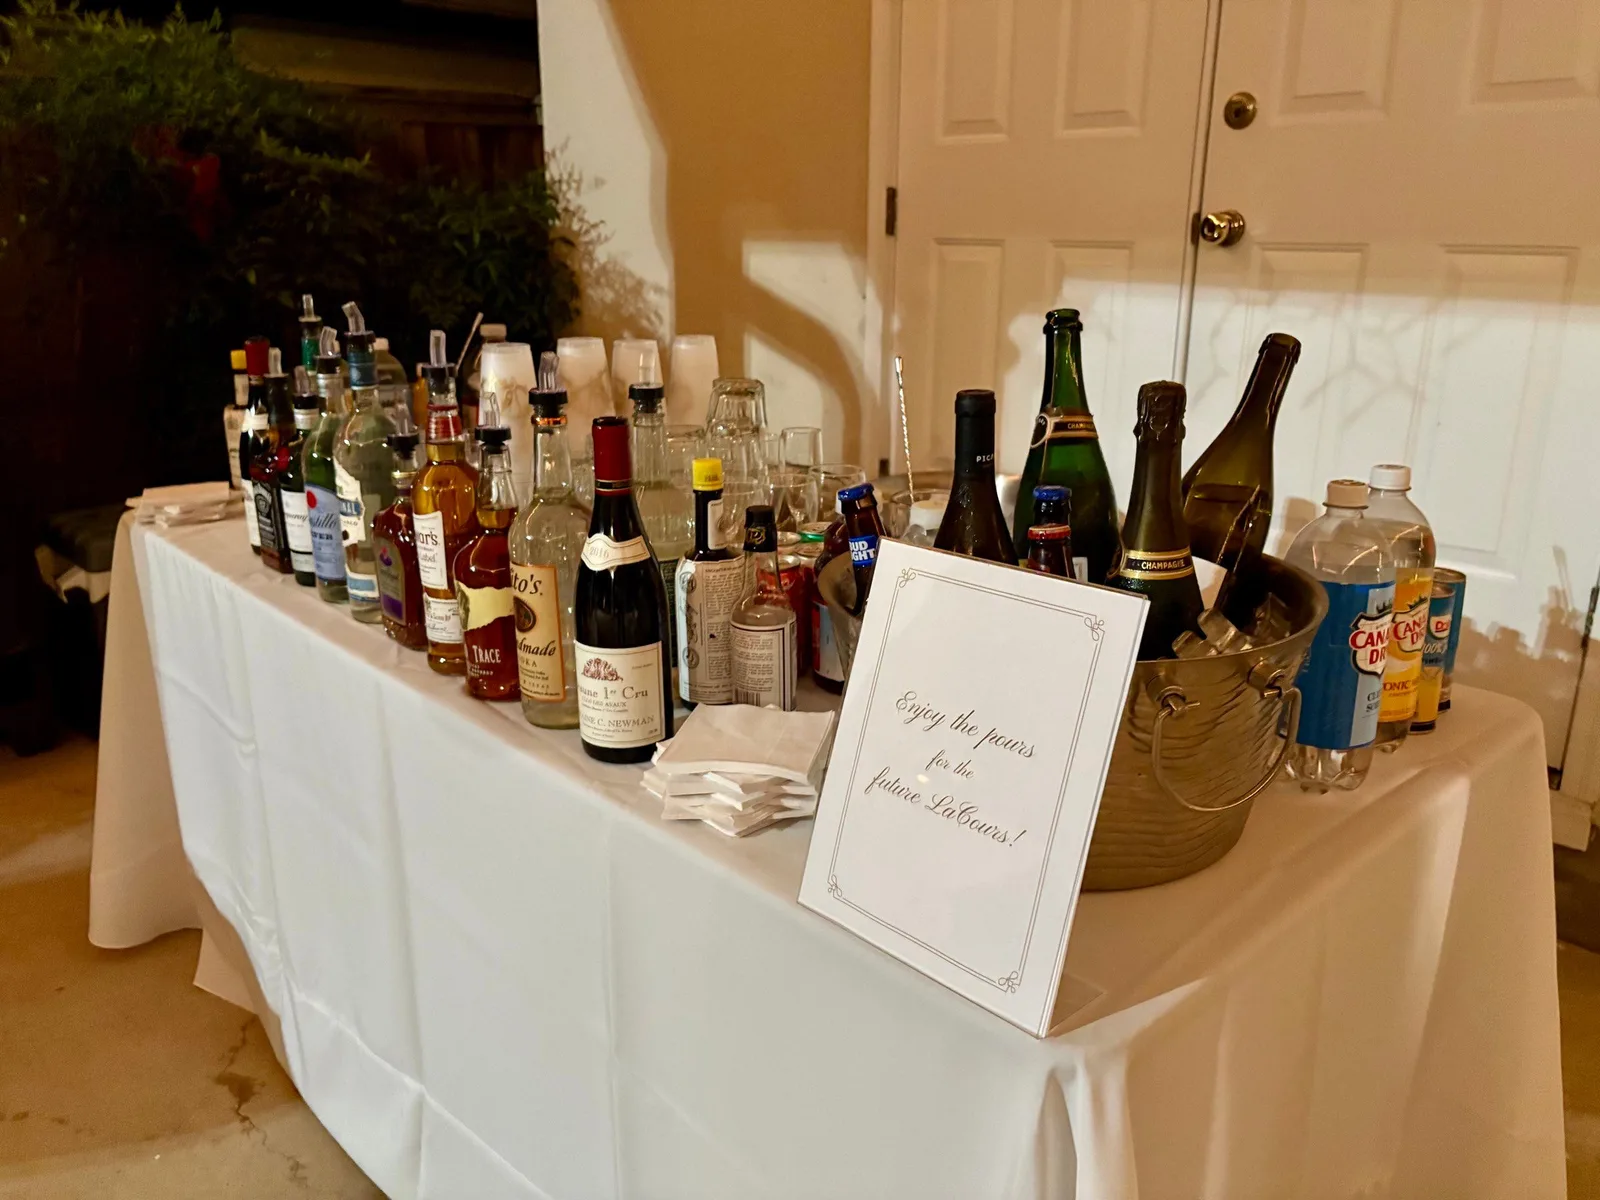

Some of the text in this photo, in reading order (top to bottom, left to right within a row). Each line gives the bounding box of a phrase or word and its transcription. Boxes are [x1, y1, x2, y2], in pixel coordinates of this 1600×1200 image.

[851, 548, 876, 561] GHT
[1141, 558, 1186, 570] CHAMPAGNE
[472, 645, 501, 663] TRACE
[518, 638, 557, 656] dmade
[1369, 646, 1386, 665] DR
[622, 686, 649, 700] Cru
[1383, 680, 1410, 692] ONIC
[608, 715, 654, 728] NEWMAN
[895, 690, 1036, 758] Enjoy the pours
[925, 749, 975, 780] for the
[864, 766, 1027, 847] future LaCours!
